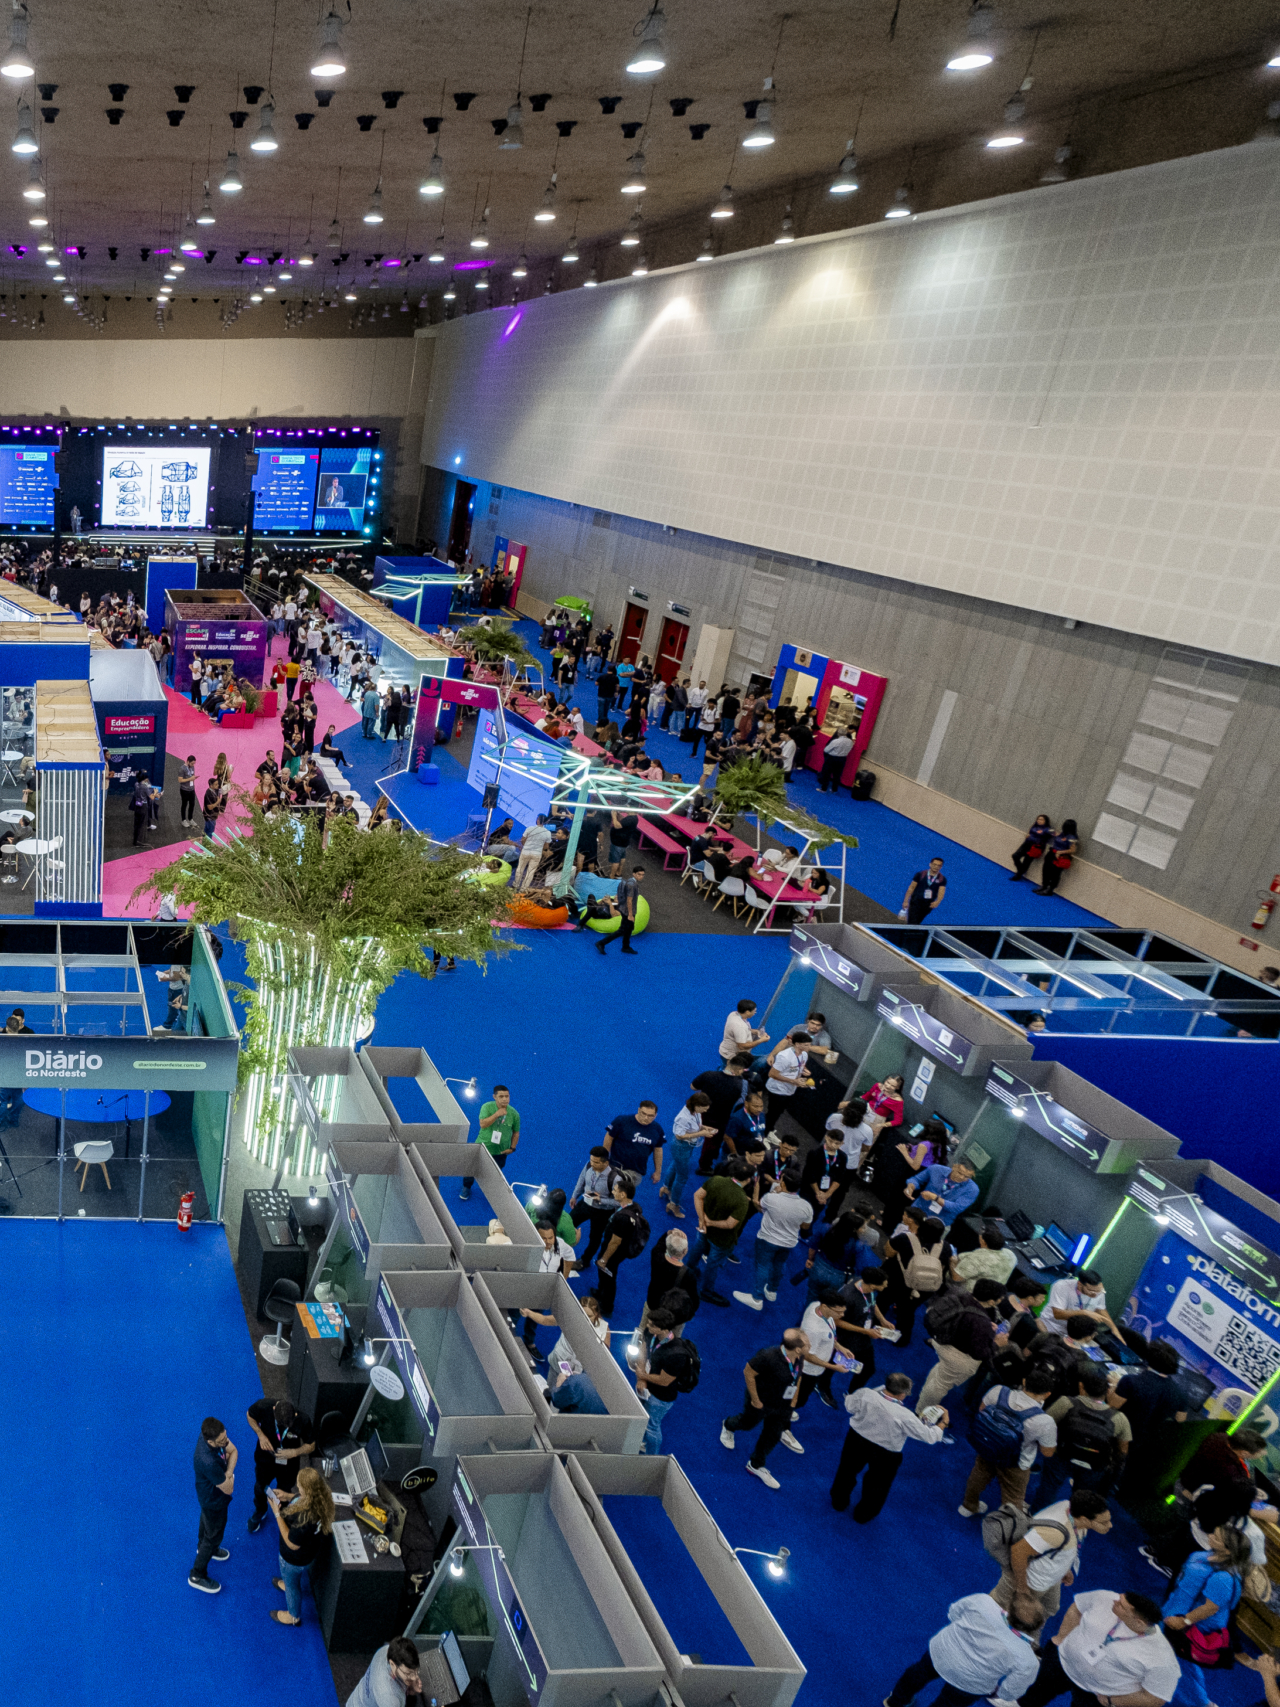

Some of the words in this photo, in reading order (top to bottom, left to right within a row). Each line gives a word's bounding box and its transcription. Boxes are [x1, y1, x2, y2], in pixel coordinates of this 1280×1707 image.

[111, 717, 149, 726] Educação
[25, 1050, 103, 1070] Diário
[40, 1069, 87, 1078] Nordeste
